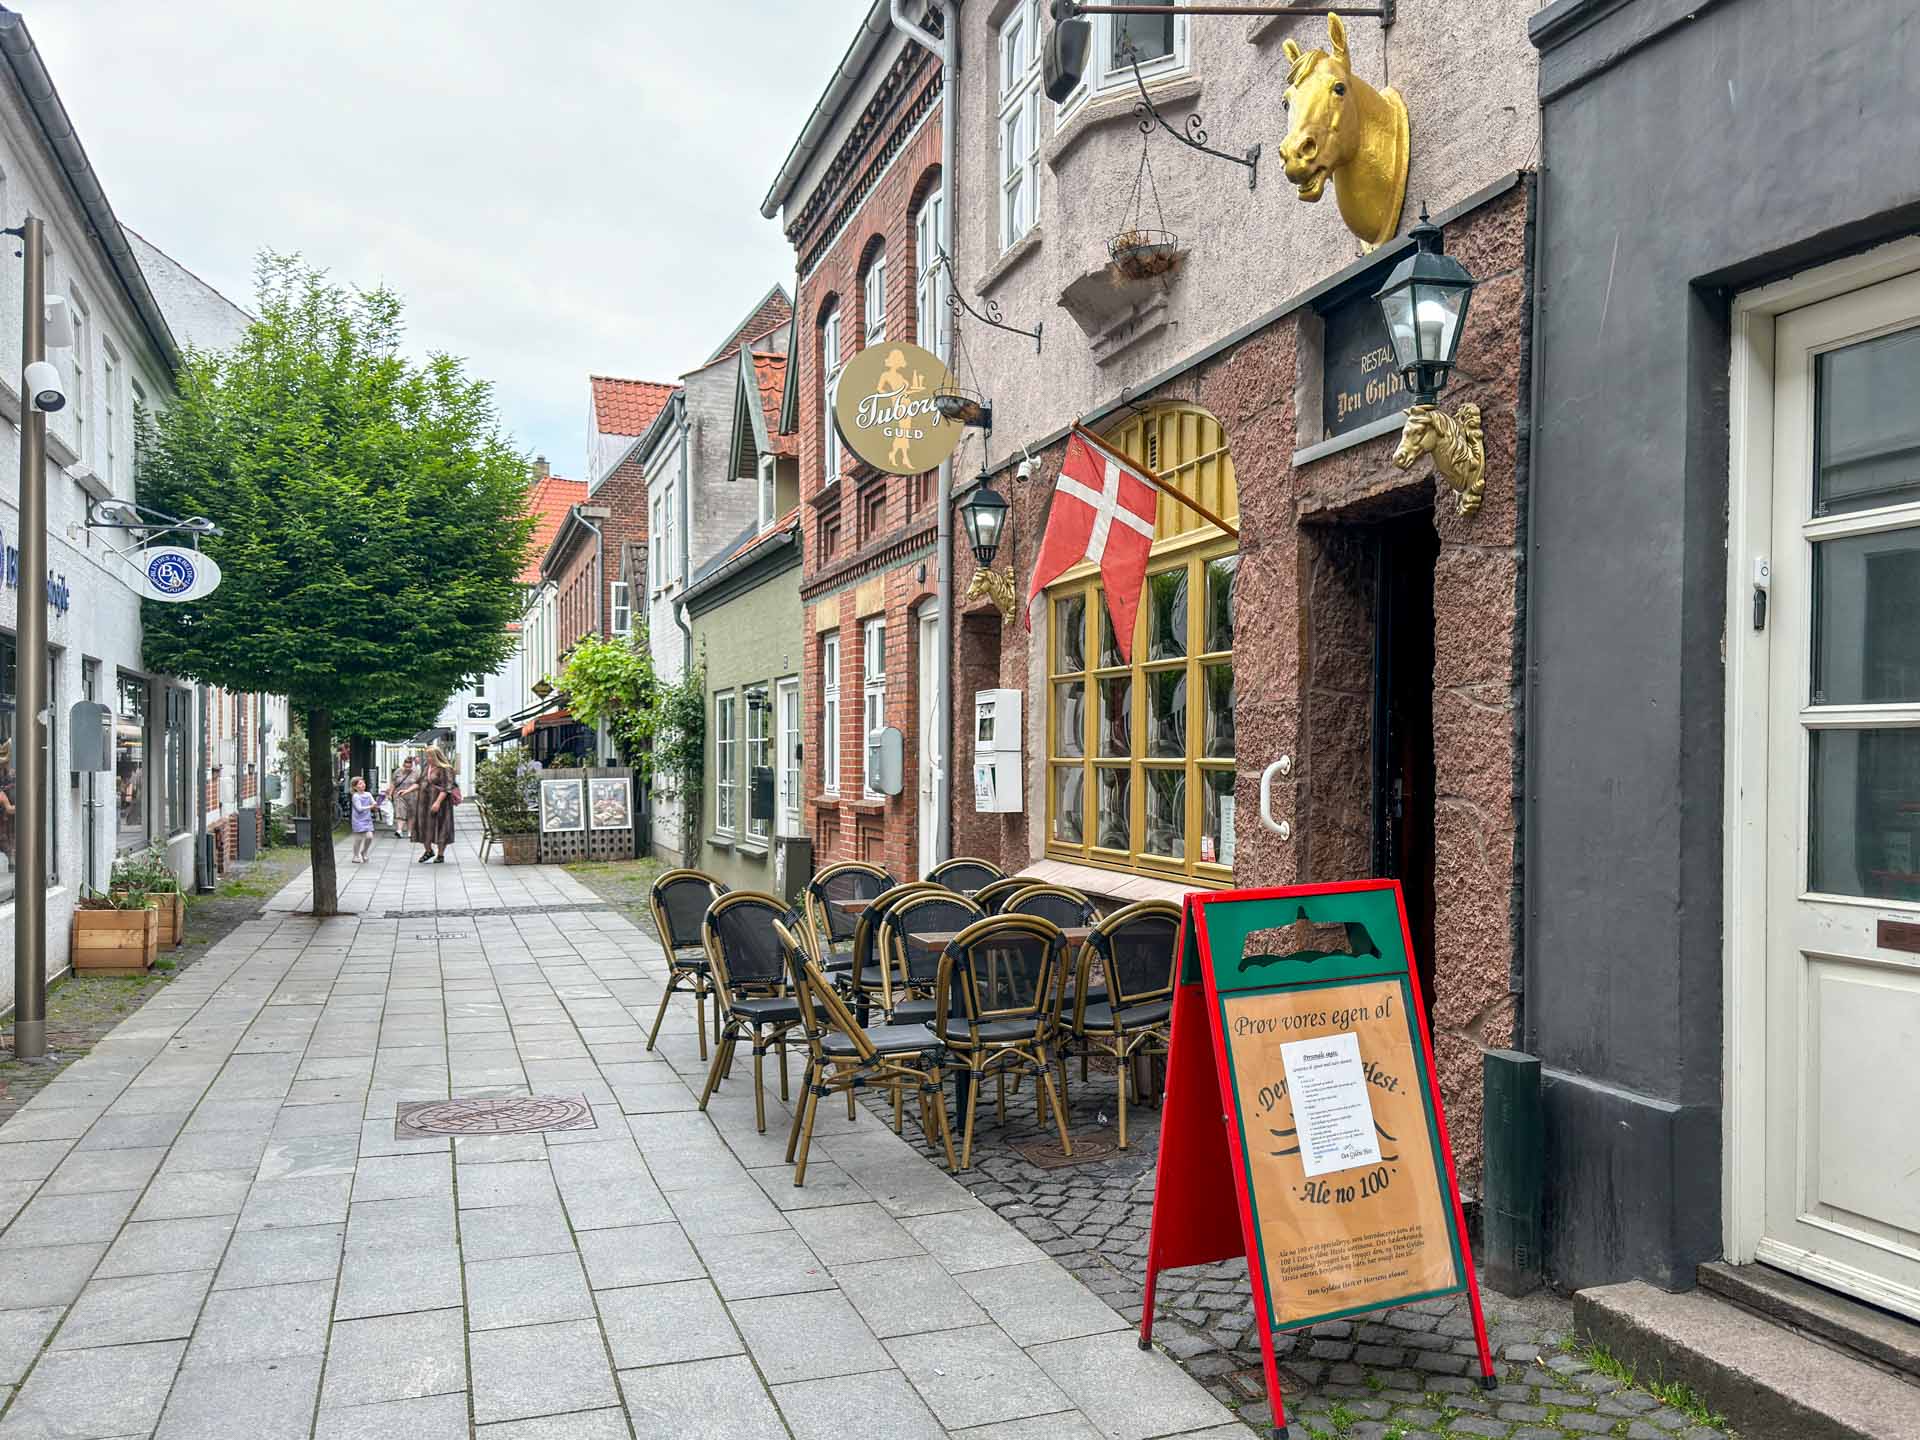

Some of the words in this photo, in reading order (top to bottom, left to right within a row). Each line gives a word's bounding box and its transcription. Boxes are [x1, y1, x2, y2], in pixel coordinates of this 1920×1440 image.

[855, 383, 942, 430] Tuborg
[1337, 392, 1361, 422] Den
[883, 426, 924, 440] GULD
[1234, 1015, 1278, 1037] Prøv
[1281, 1010, 1327, 1030] vores
[1332, 1006, 1370, 1030] egen
[1375, 996, 1393, 1018] øl
[1299, 1180, 1331, 1204] Ale
[1335, 1185, 1356, 1203] no
[1360, 1166, 1389, 1198] 100
